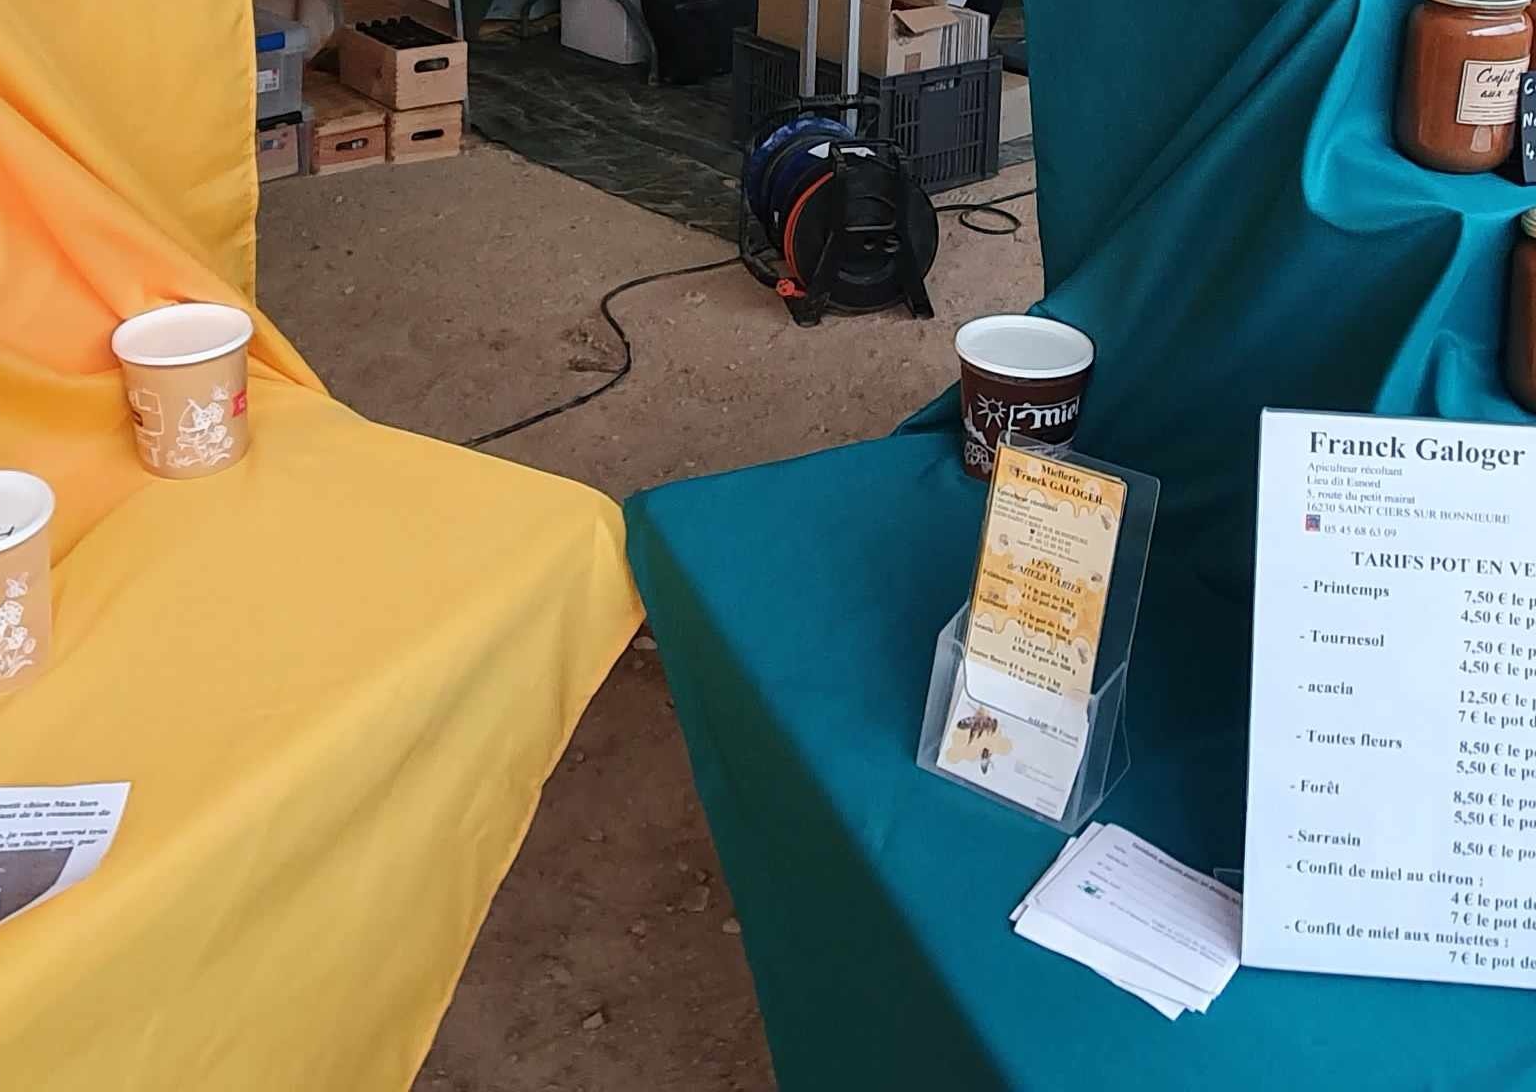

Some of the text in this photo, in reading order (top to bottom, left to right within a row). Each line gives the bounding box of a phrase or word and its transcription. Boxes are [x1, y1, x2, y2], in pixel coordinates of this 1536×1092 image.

[1310, 431, 1526, 470] Franck Galoger
[1049, 481, 1102, 505] GALOGER
[1351, 550, 1425, 571] TARIFS
[1430, 556, 1471, 574] POT
[1476, 559, 1503, 575] EN
[1313, 579, 1389, 600] Printemps
[1296, 859, 1473, 886] Confit de miel au citron
[1294, 919, 1499, 947] Confit de miel aux noisettes
